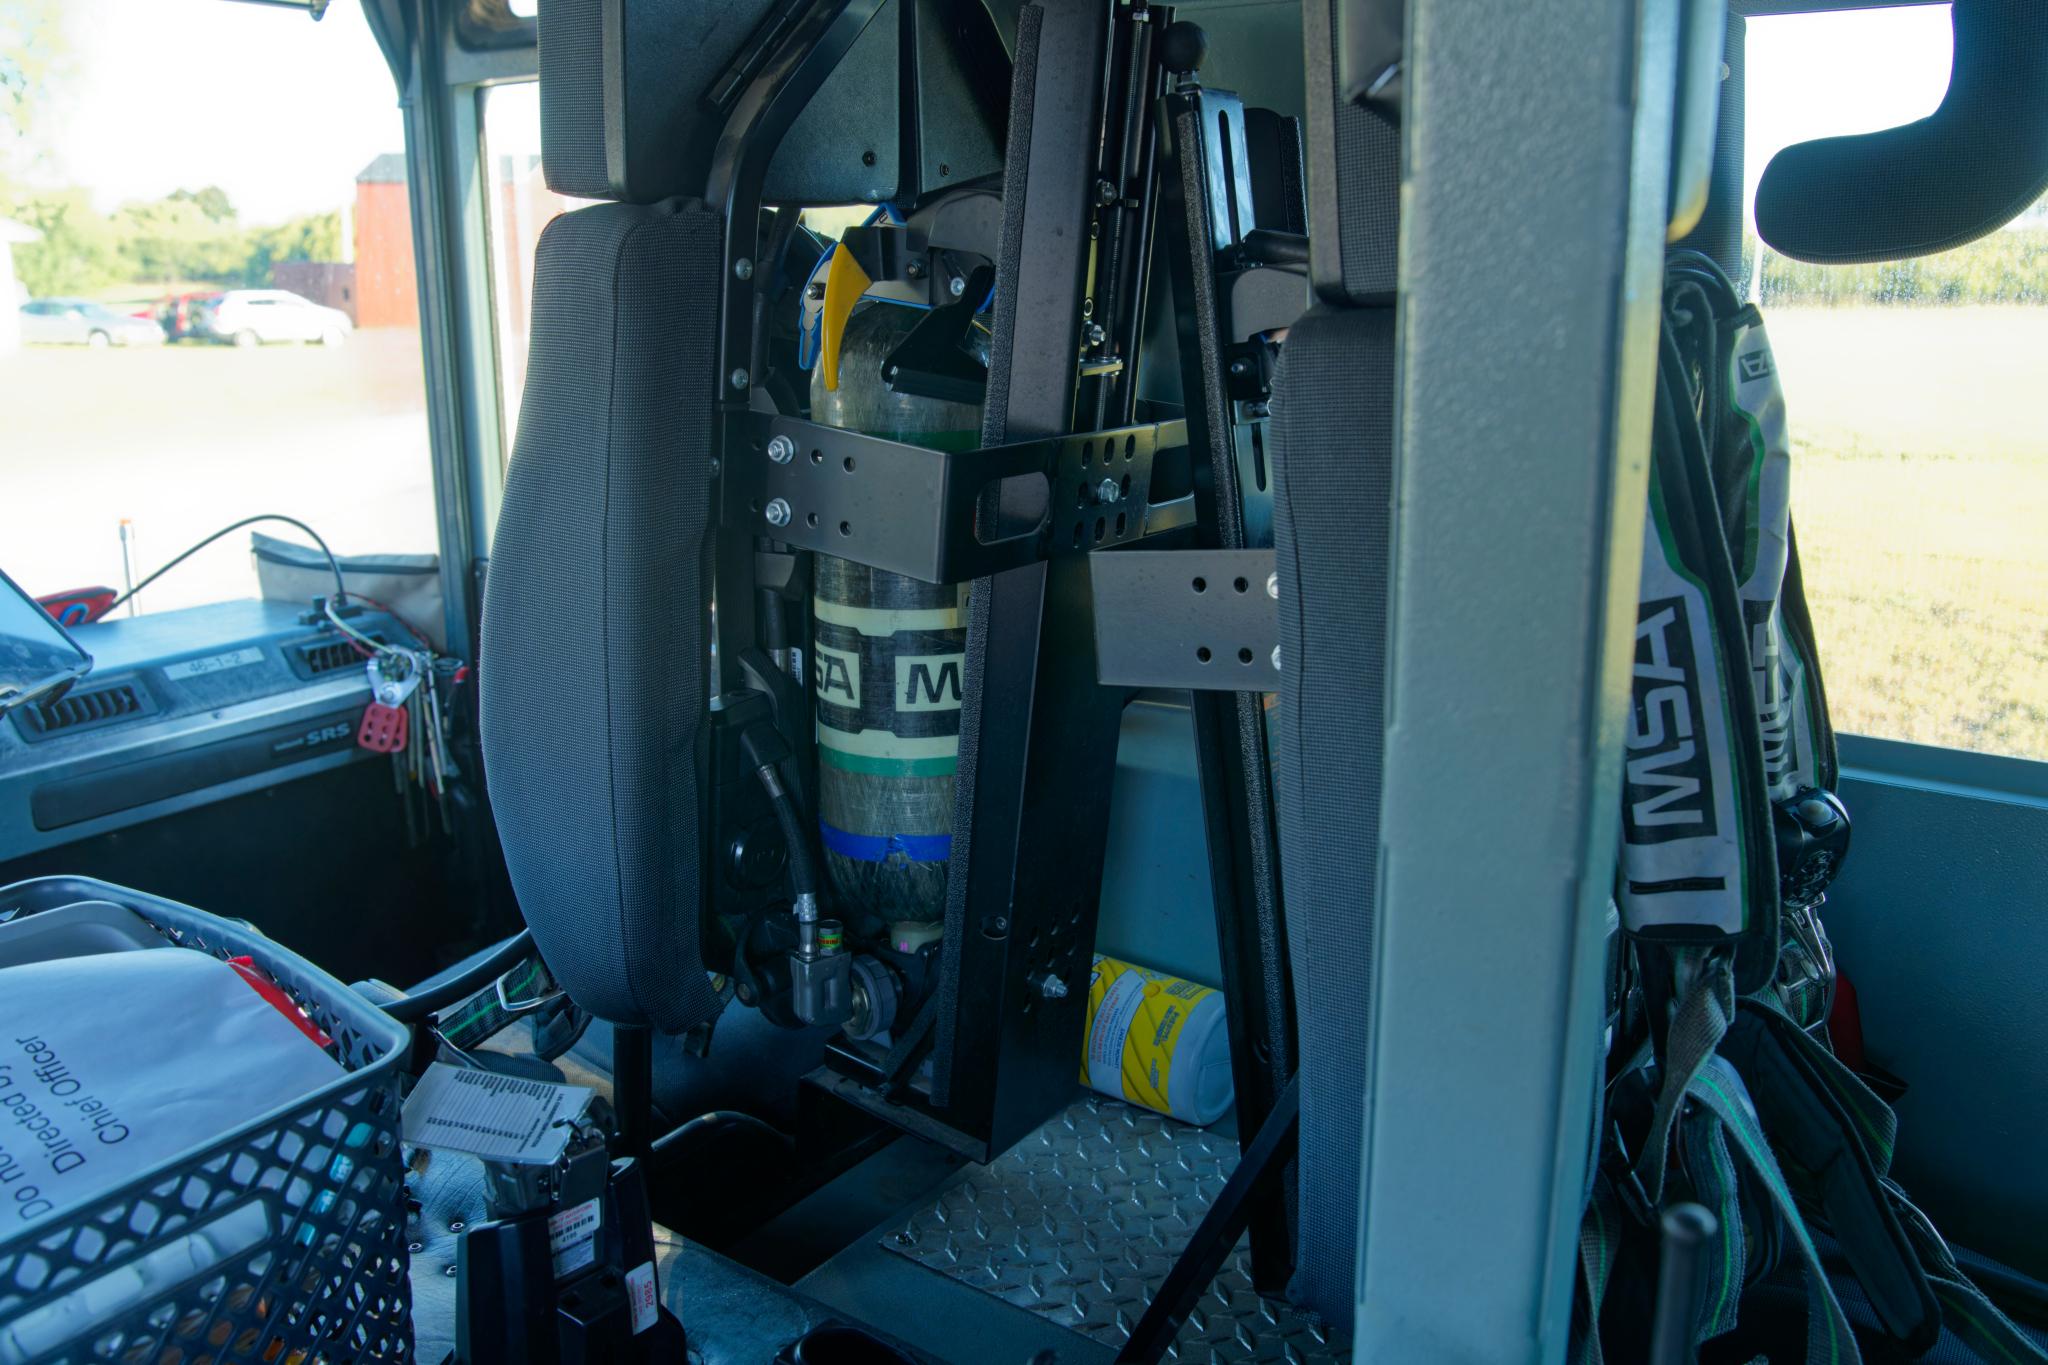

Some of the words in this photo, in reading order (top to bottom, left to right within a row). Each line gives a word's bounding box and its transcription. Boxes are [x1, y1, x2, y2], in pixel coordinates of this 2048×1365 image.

[306, 722, 351, 746] SRS
[1624, 606, 1703, 827] MSA
[15, 1035, 82, 1097] Officer
[0, 1092, 87, 1175] Directed
[64, 1095, 130, 1145] Chief
[0, 1146, 25, 1184] no
[14, 1185, 54, 1221] Do
